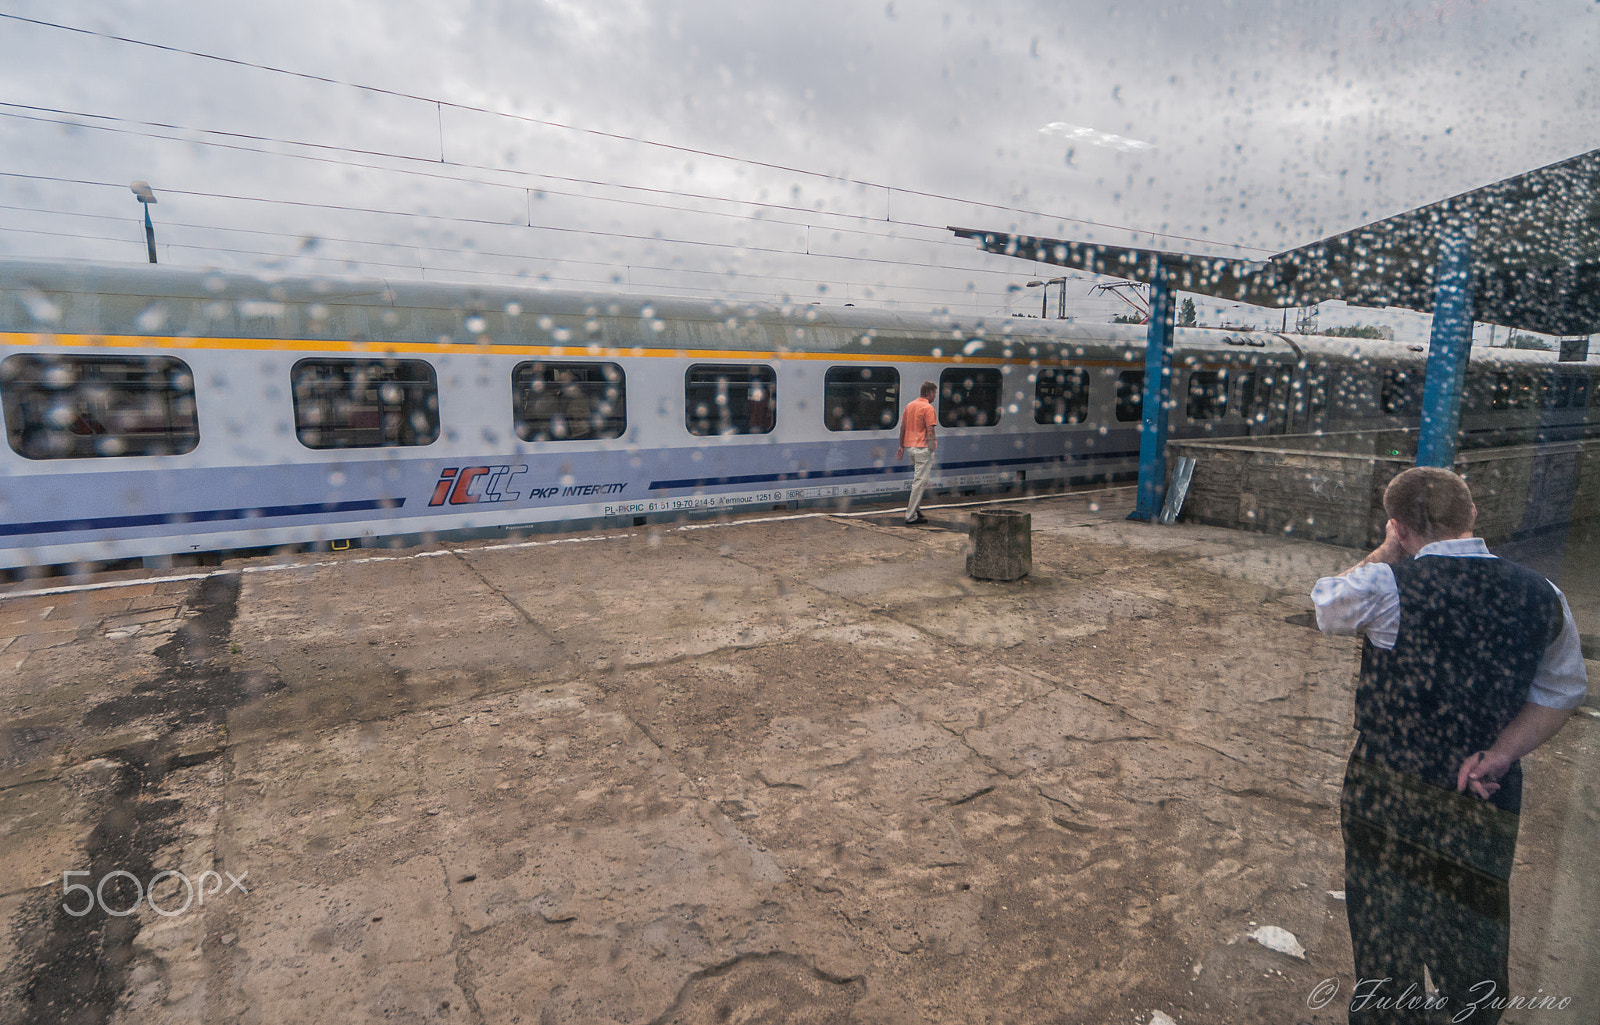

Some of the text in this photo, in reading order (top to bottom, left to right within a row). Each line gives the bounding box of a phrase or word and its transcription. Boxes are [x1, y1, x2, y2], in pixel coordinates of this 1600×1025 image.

[529, 482, 628, 499] PKP INTERCITY
[604, 504, 644, 515] PL-PKPIC
[648, 503, 658, 511] 61
[661, 501, 669, 510] 51
[673, 499, 693, 509] 19-70
[695, 498, 715, 507] 214-5
[756, 493, 771, 501] 1251
